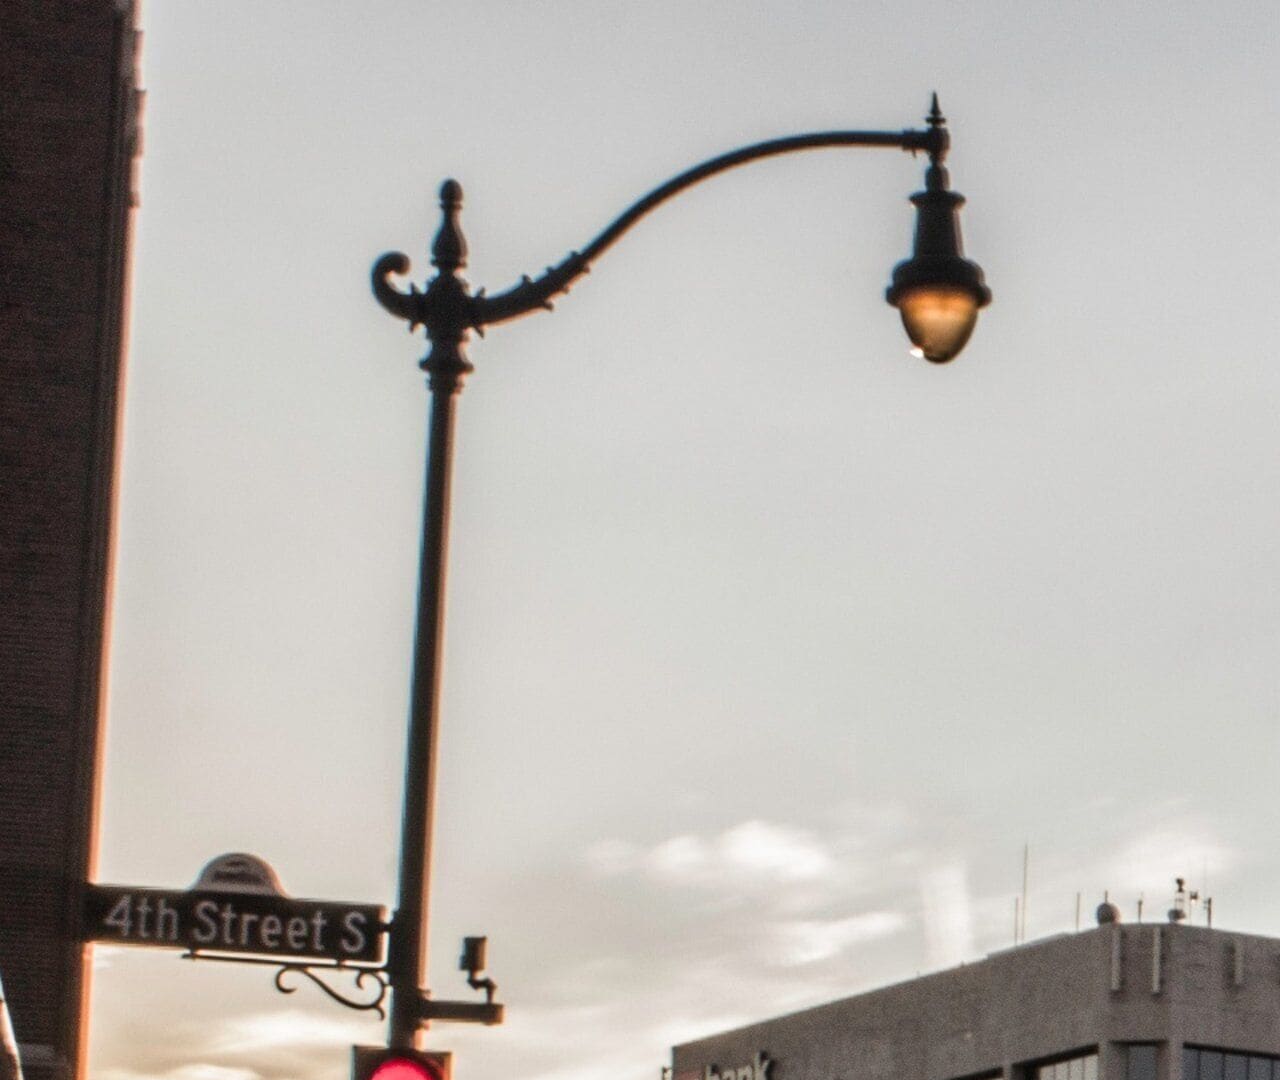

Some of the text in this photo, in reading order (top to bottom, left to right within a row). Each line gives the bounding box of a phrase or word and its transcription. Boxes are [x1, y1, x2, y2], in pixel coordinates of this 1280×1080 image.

[102, 895, 367, 954] 4th Street S
